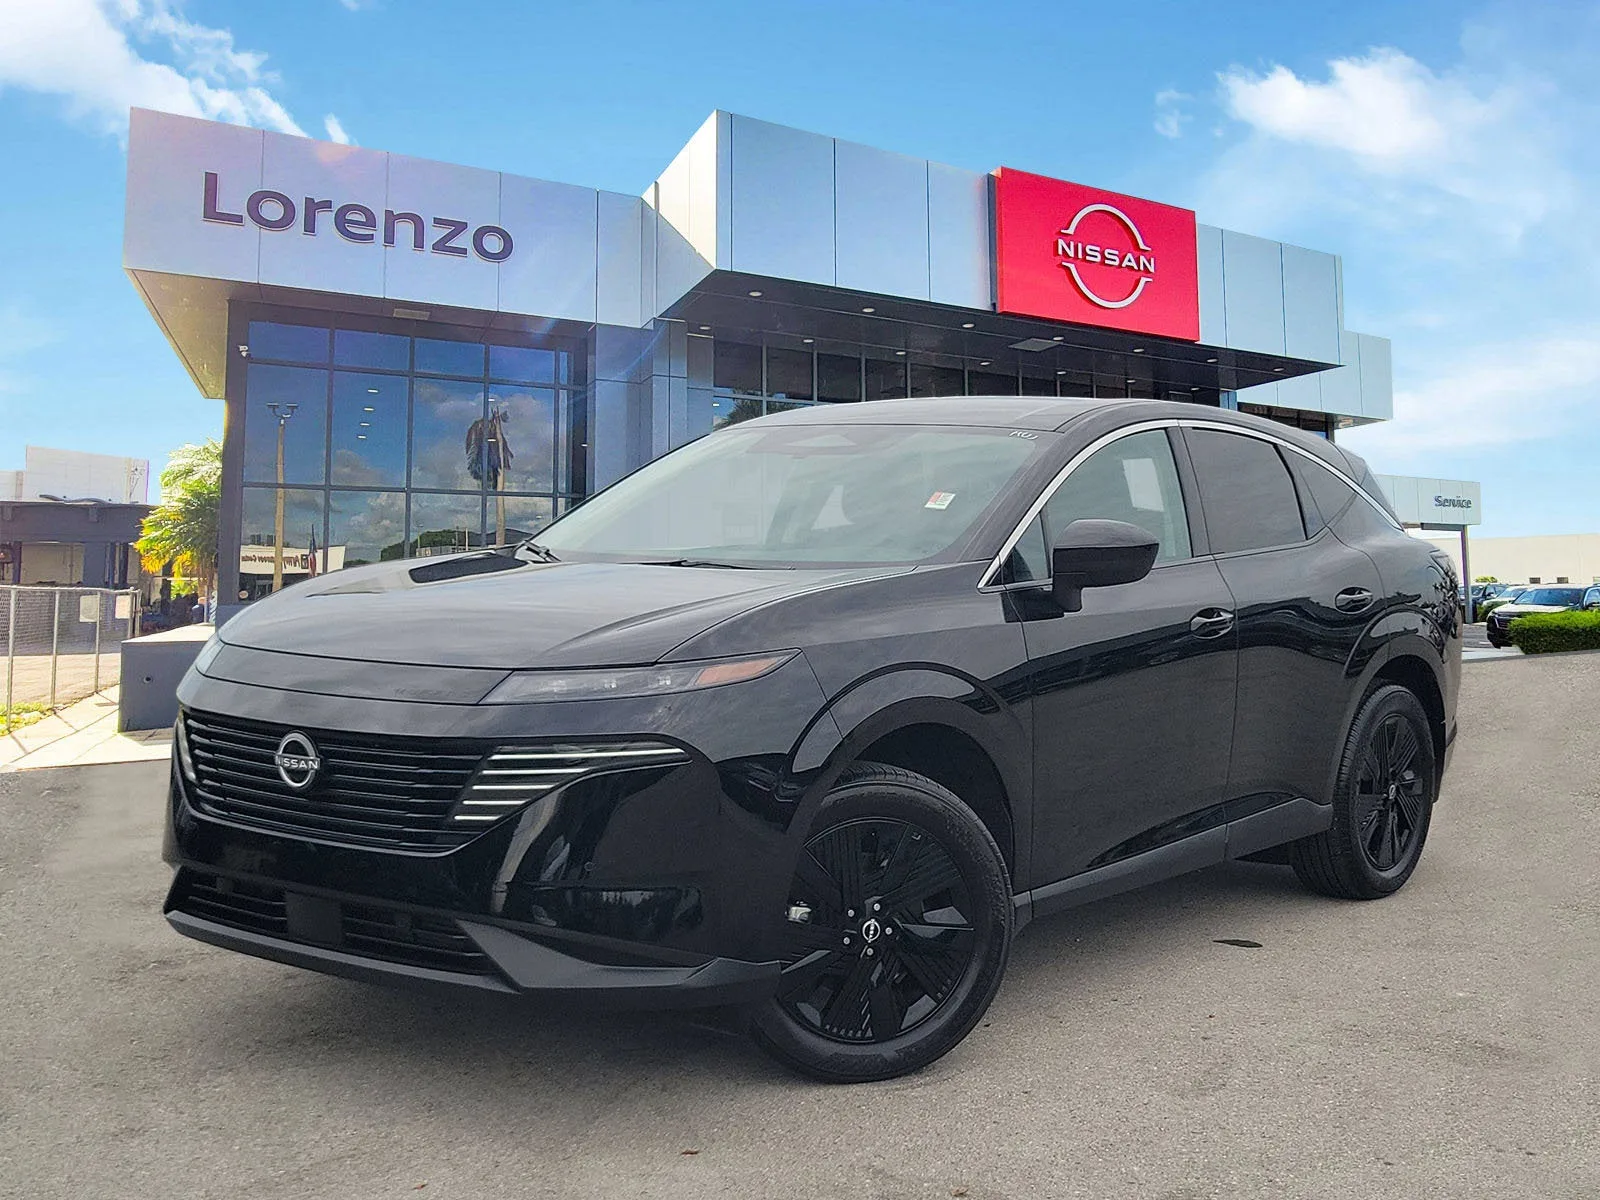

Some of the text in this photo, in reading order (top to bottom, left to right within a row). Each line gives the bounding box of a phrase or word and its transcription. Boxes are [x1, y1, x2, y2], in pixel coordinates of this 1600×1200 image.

[202, 171, 514, 262] Lorenzo
[1057, 238, 1155, 273] NISSAN
[1434, 495, 1472, 508] Service
